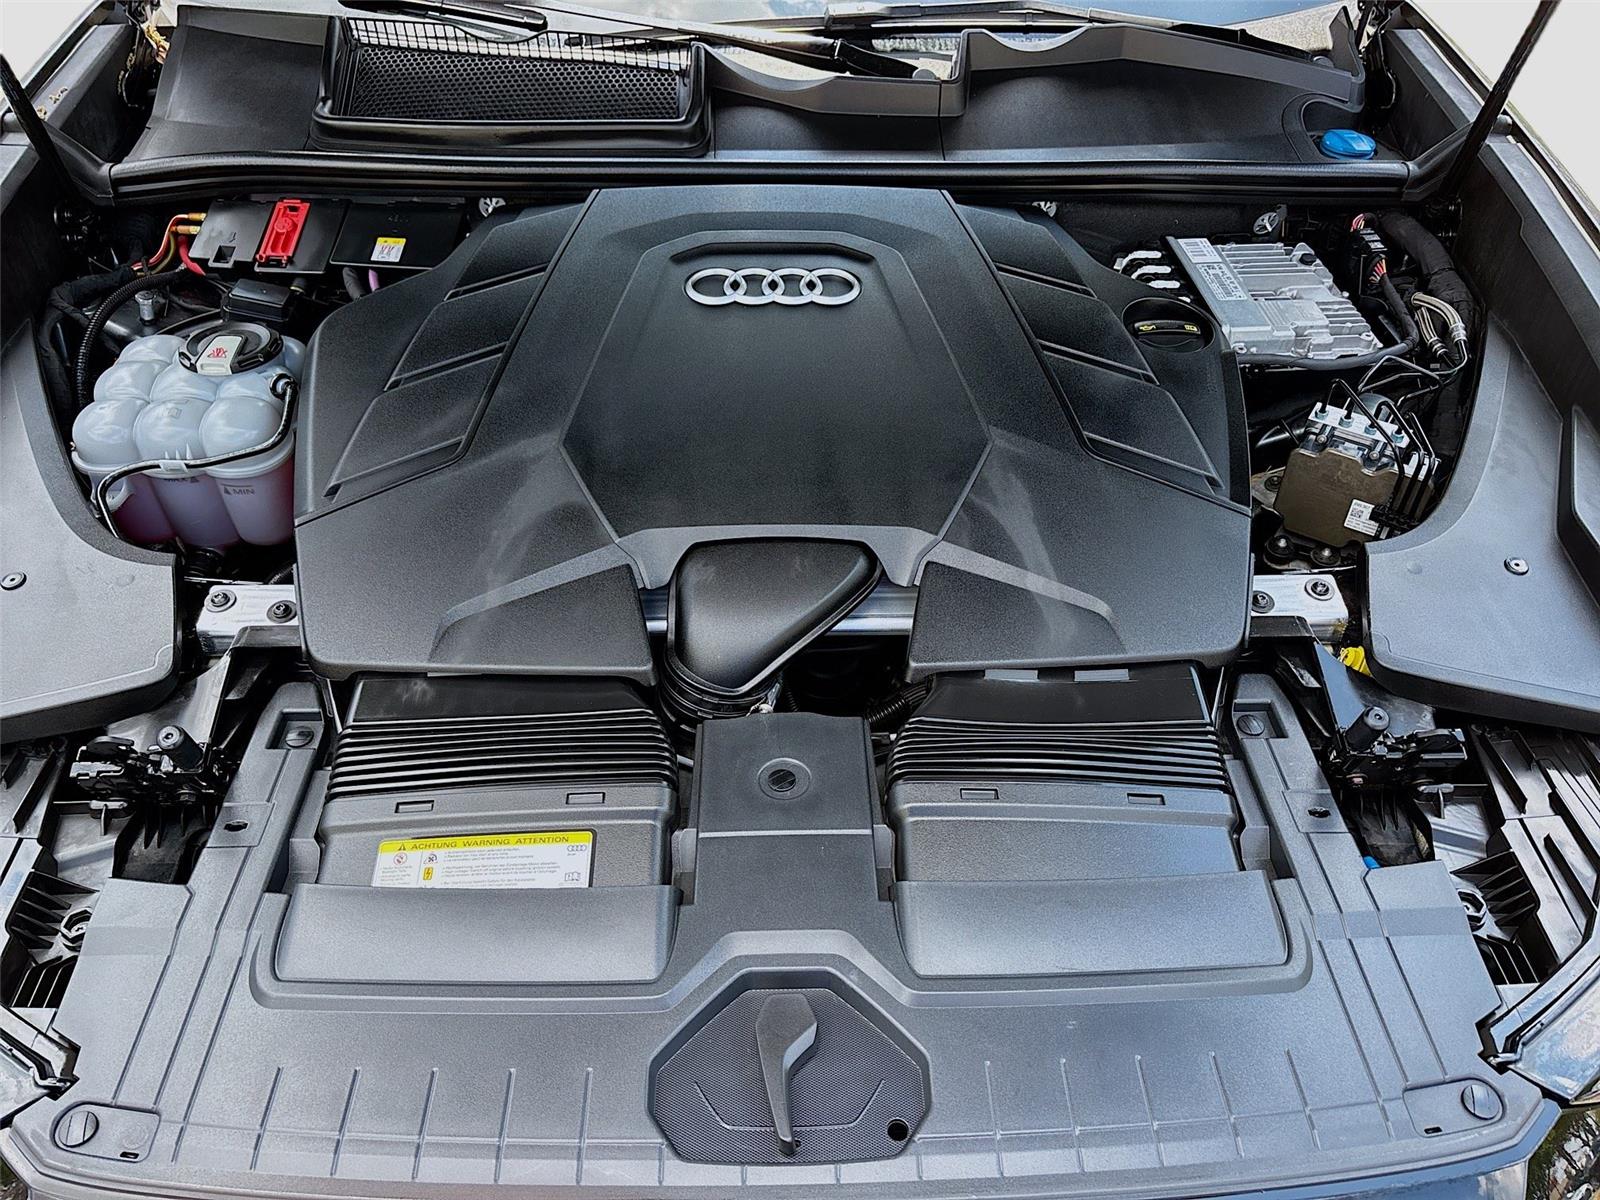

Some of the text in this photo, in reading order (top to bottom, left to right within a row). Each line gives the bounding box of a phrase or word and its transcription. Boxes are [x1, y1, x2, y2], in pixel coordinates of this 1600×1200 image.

[411, 836, 569, 850] ACHTUNG WARNING ATTENTION
